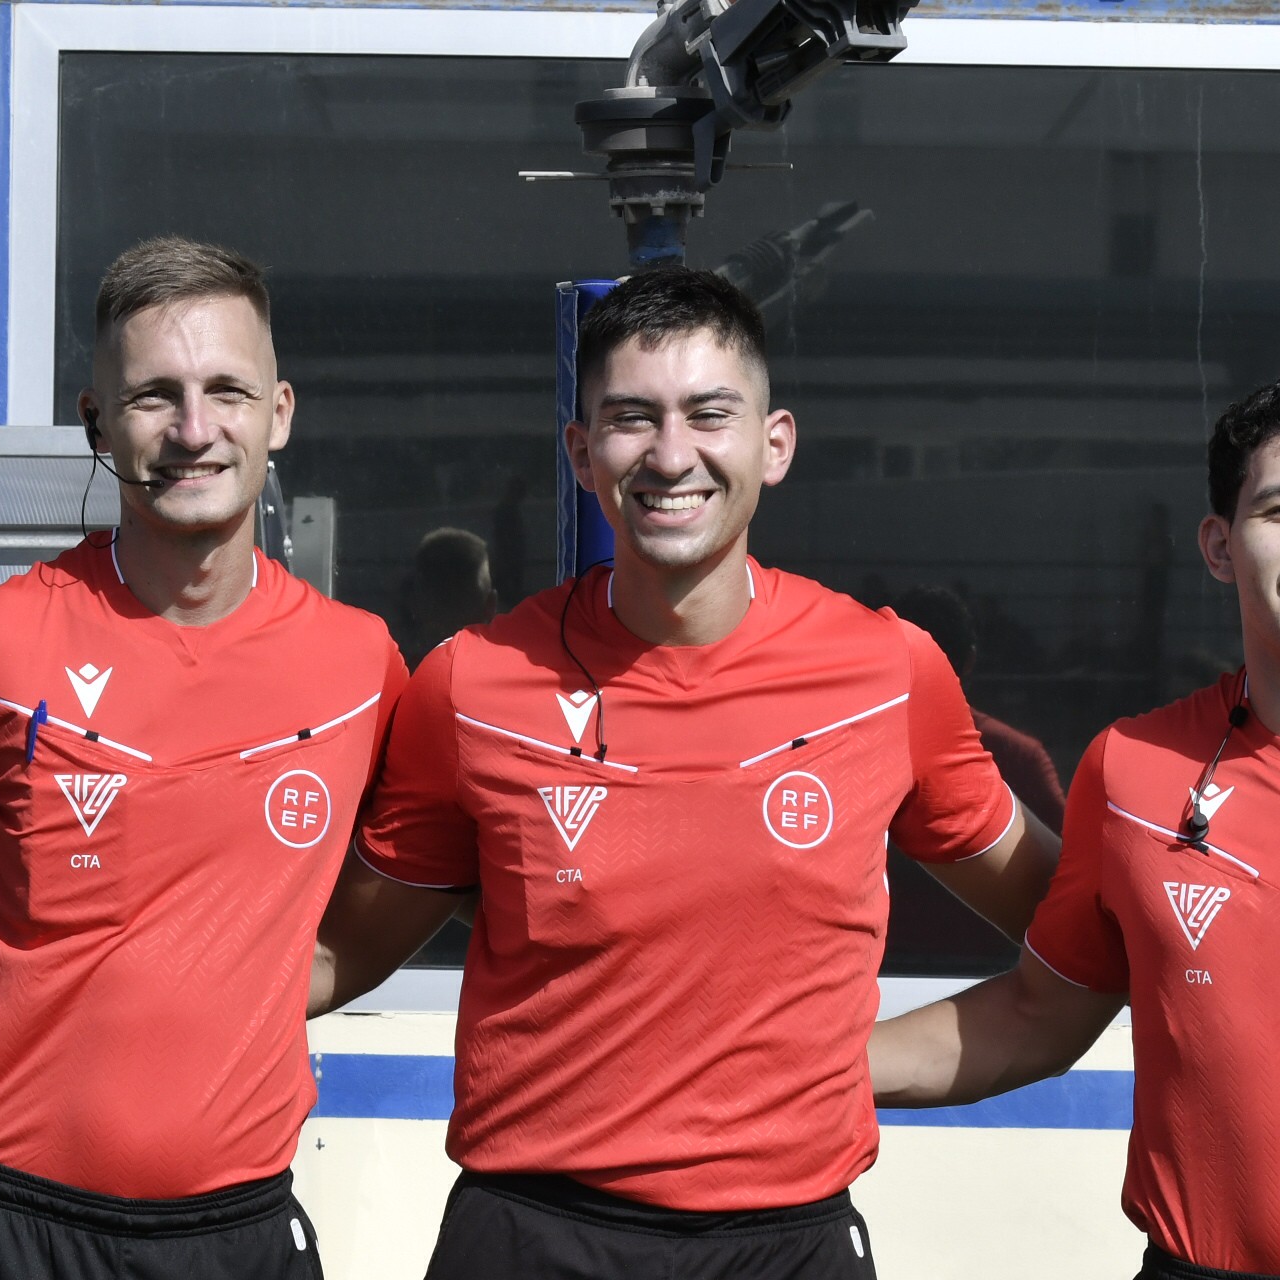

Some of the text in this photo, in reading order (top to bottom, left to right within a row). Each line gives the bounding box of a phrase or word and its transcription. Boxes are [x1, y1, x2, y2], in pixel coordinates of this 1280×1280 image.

[70, 855, 101, 869] CTA
[556, 869, 583, 883] CTA
[1185, 969, 1213, 985] CTA
